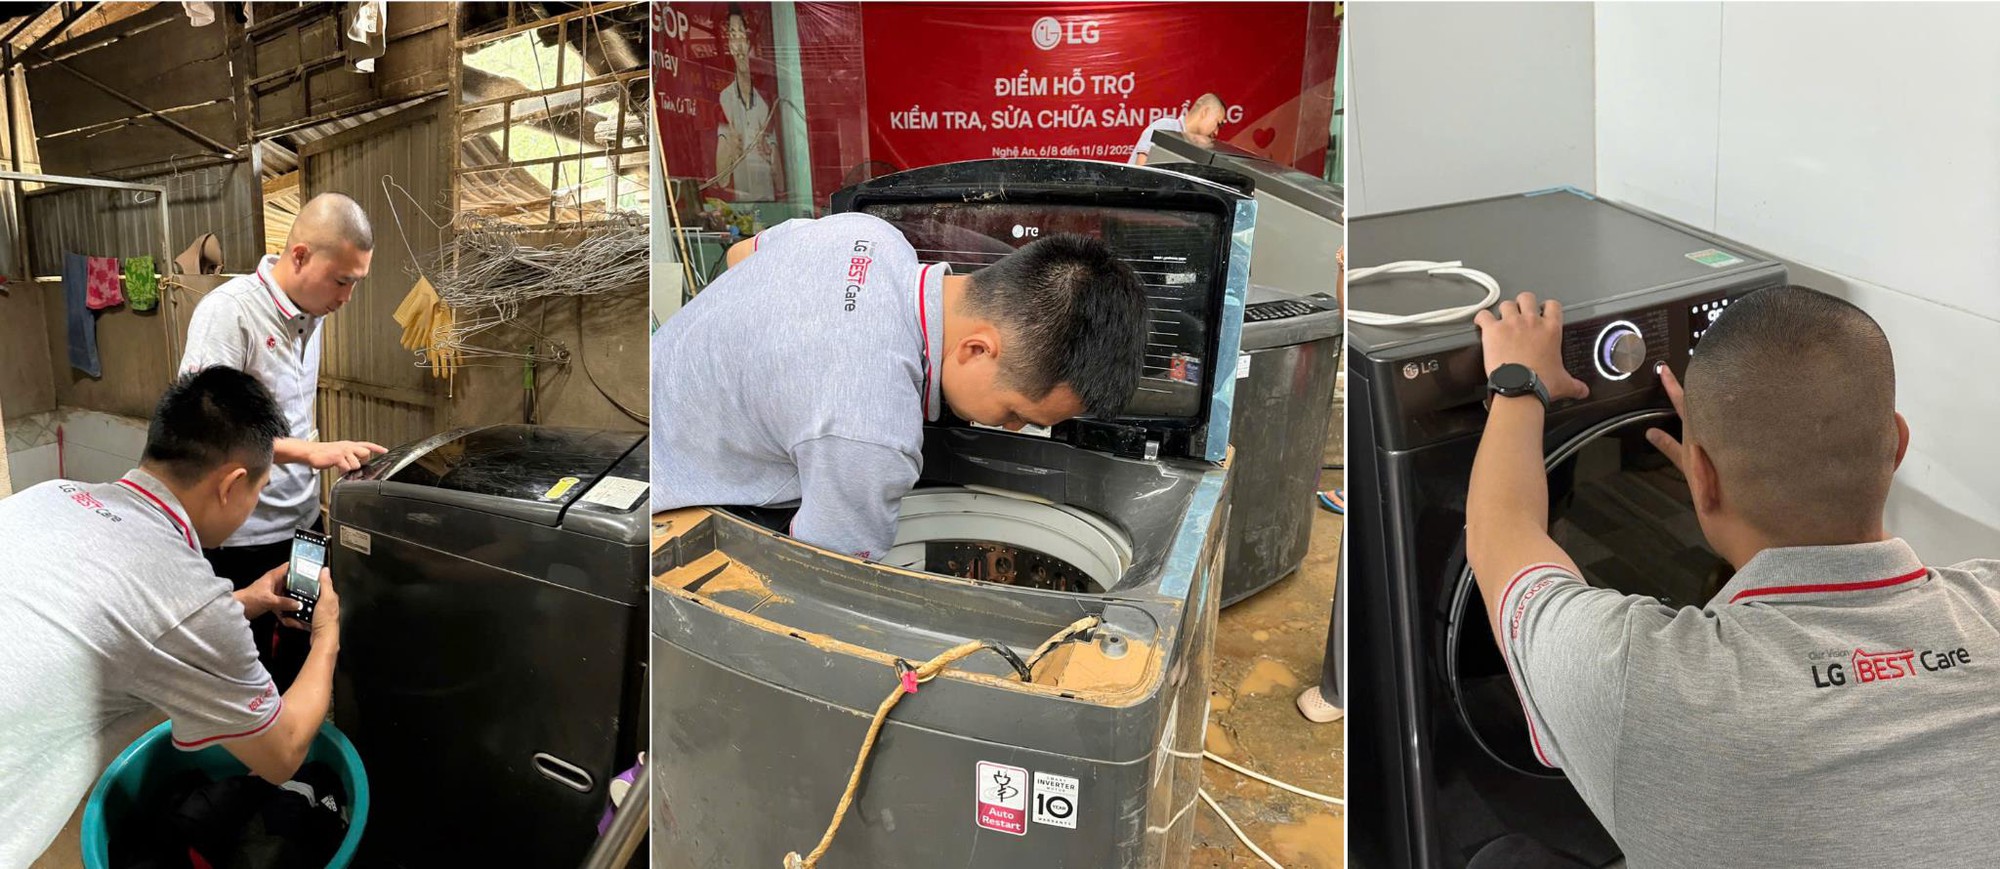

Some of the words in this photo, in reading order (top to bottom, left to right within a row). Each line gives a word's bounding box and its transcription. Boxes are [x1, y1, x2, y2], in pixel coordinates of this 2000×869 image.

[1066, 21, 1100, 44] LG
[995, 69, 1048, 97] ĐIỂM
[1053, 68, 1086, 96] HỖ
[1091, 72, 1135, 99] TRỢ
[890, 104, 938, 129] KIỂM
[942, 111, 987, 132] TRA,
[991, 104, 1033, 129] SỬA
[1037, 104, 1097, 128] CHỮA
[1101, 102, 1144, 127] SẢN
[992, 147, 1018, 158] Nghệ
[1040, 146, 1056, 156] 6/8
[1060, 145, 1079, 156] đến
[854, 240, 869, 252] LG
[847, 257, 866, 285] BEST
[845, 284, 861, 312] Care
[1421, 360, 1439, 374] LG
[59, 484, 76, 493] LG
[1811, 663, 1846, 688] LG
[1854, 650, 1917, 684] BEST
[1920, 647, 1971, 672] Care
[1037, 778, 1075, 790] INVERTER
[988, 807, 1014, 820] Auto
[1037, 793, 1073, 819] 10
[982, 815, 1021, 831] Restart
